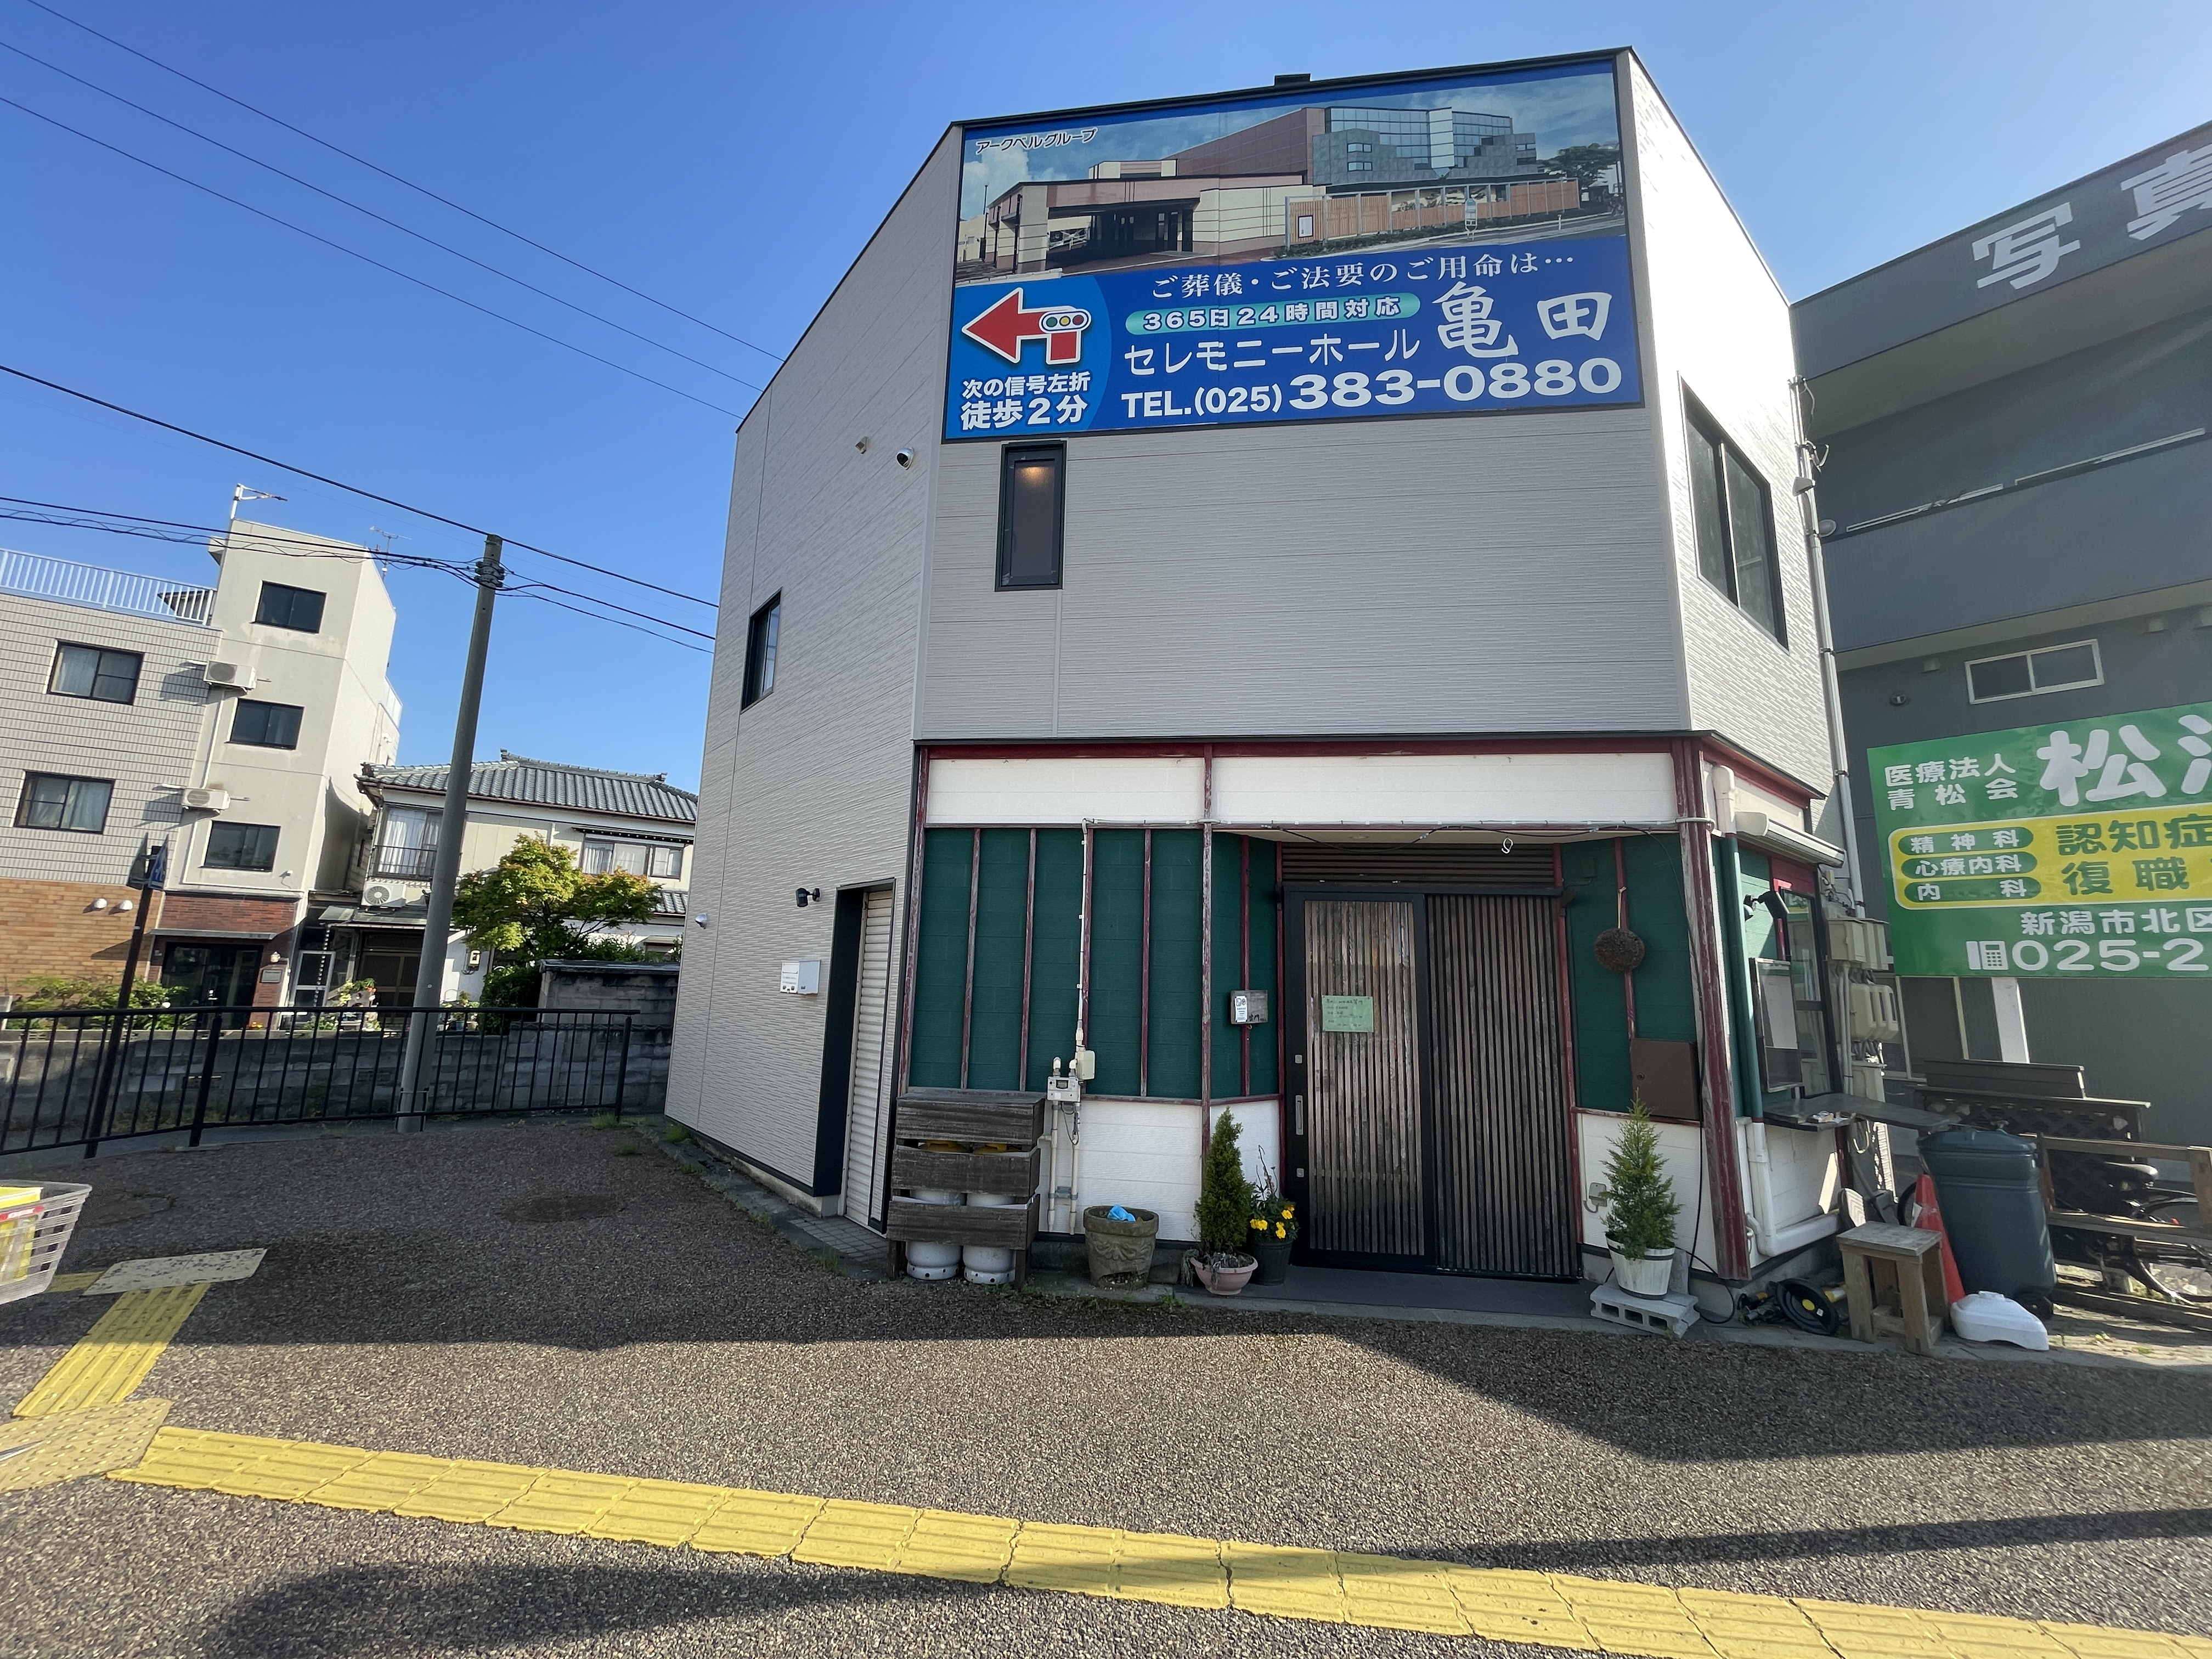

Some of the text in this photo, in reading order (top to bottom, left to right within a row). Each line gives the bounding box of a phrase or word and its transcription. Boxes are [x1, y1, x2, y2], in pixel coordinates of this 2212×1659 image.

[975, 127, 1098, 154] アークベルグループ
[1125, 281, 1613, 376] セレモニーホール 亀田
[1143, 296, 1402, 330] 365日24時間対応
[962, 371, 1091, 399] 次の信号左折
[961, 394, 1088, 430] 徒歩2分
[1884, 752, 2016, 788] 医療法人
[1887, 777, 2018, 811] 青松会
[1910, 829, 2019, 854] 精神科
[1915, 855, 2022, 877] 心療内科
[2021, 907, 2212, 936] 新潟市北区
[2011, 937, 2209, 972] 025-2
